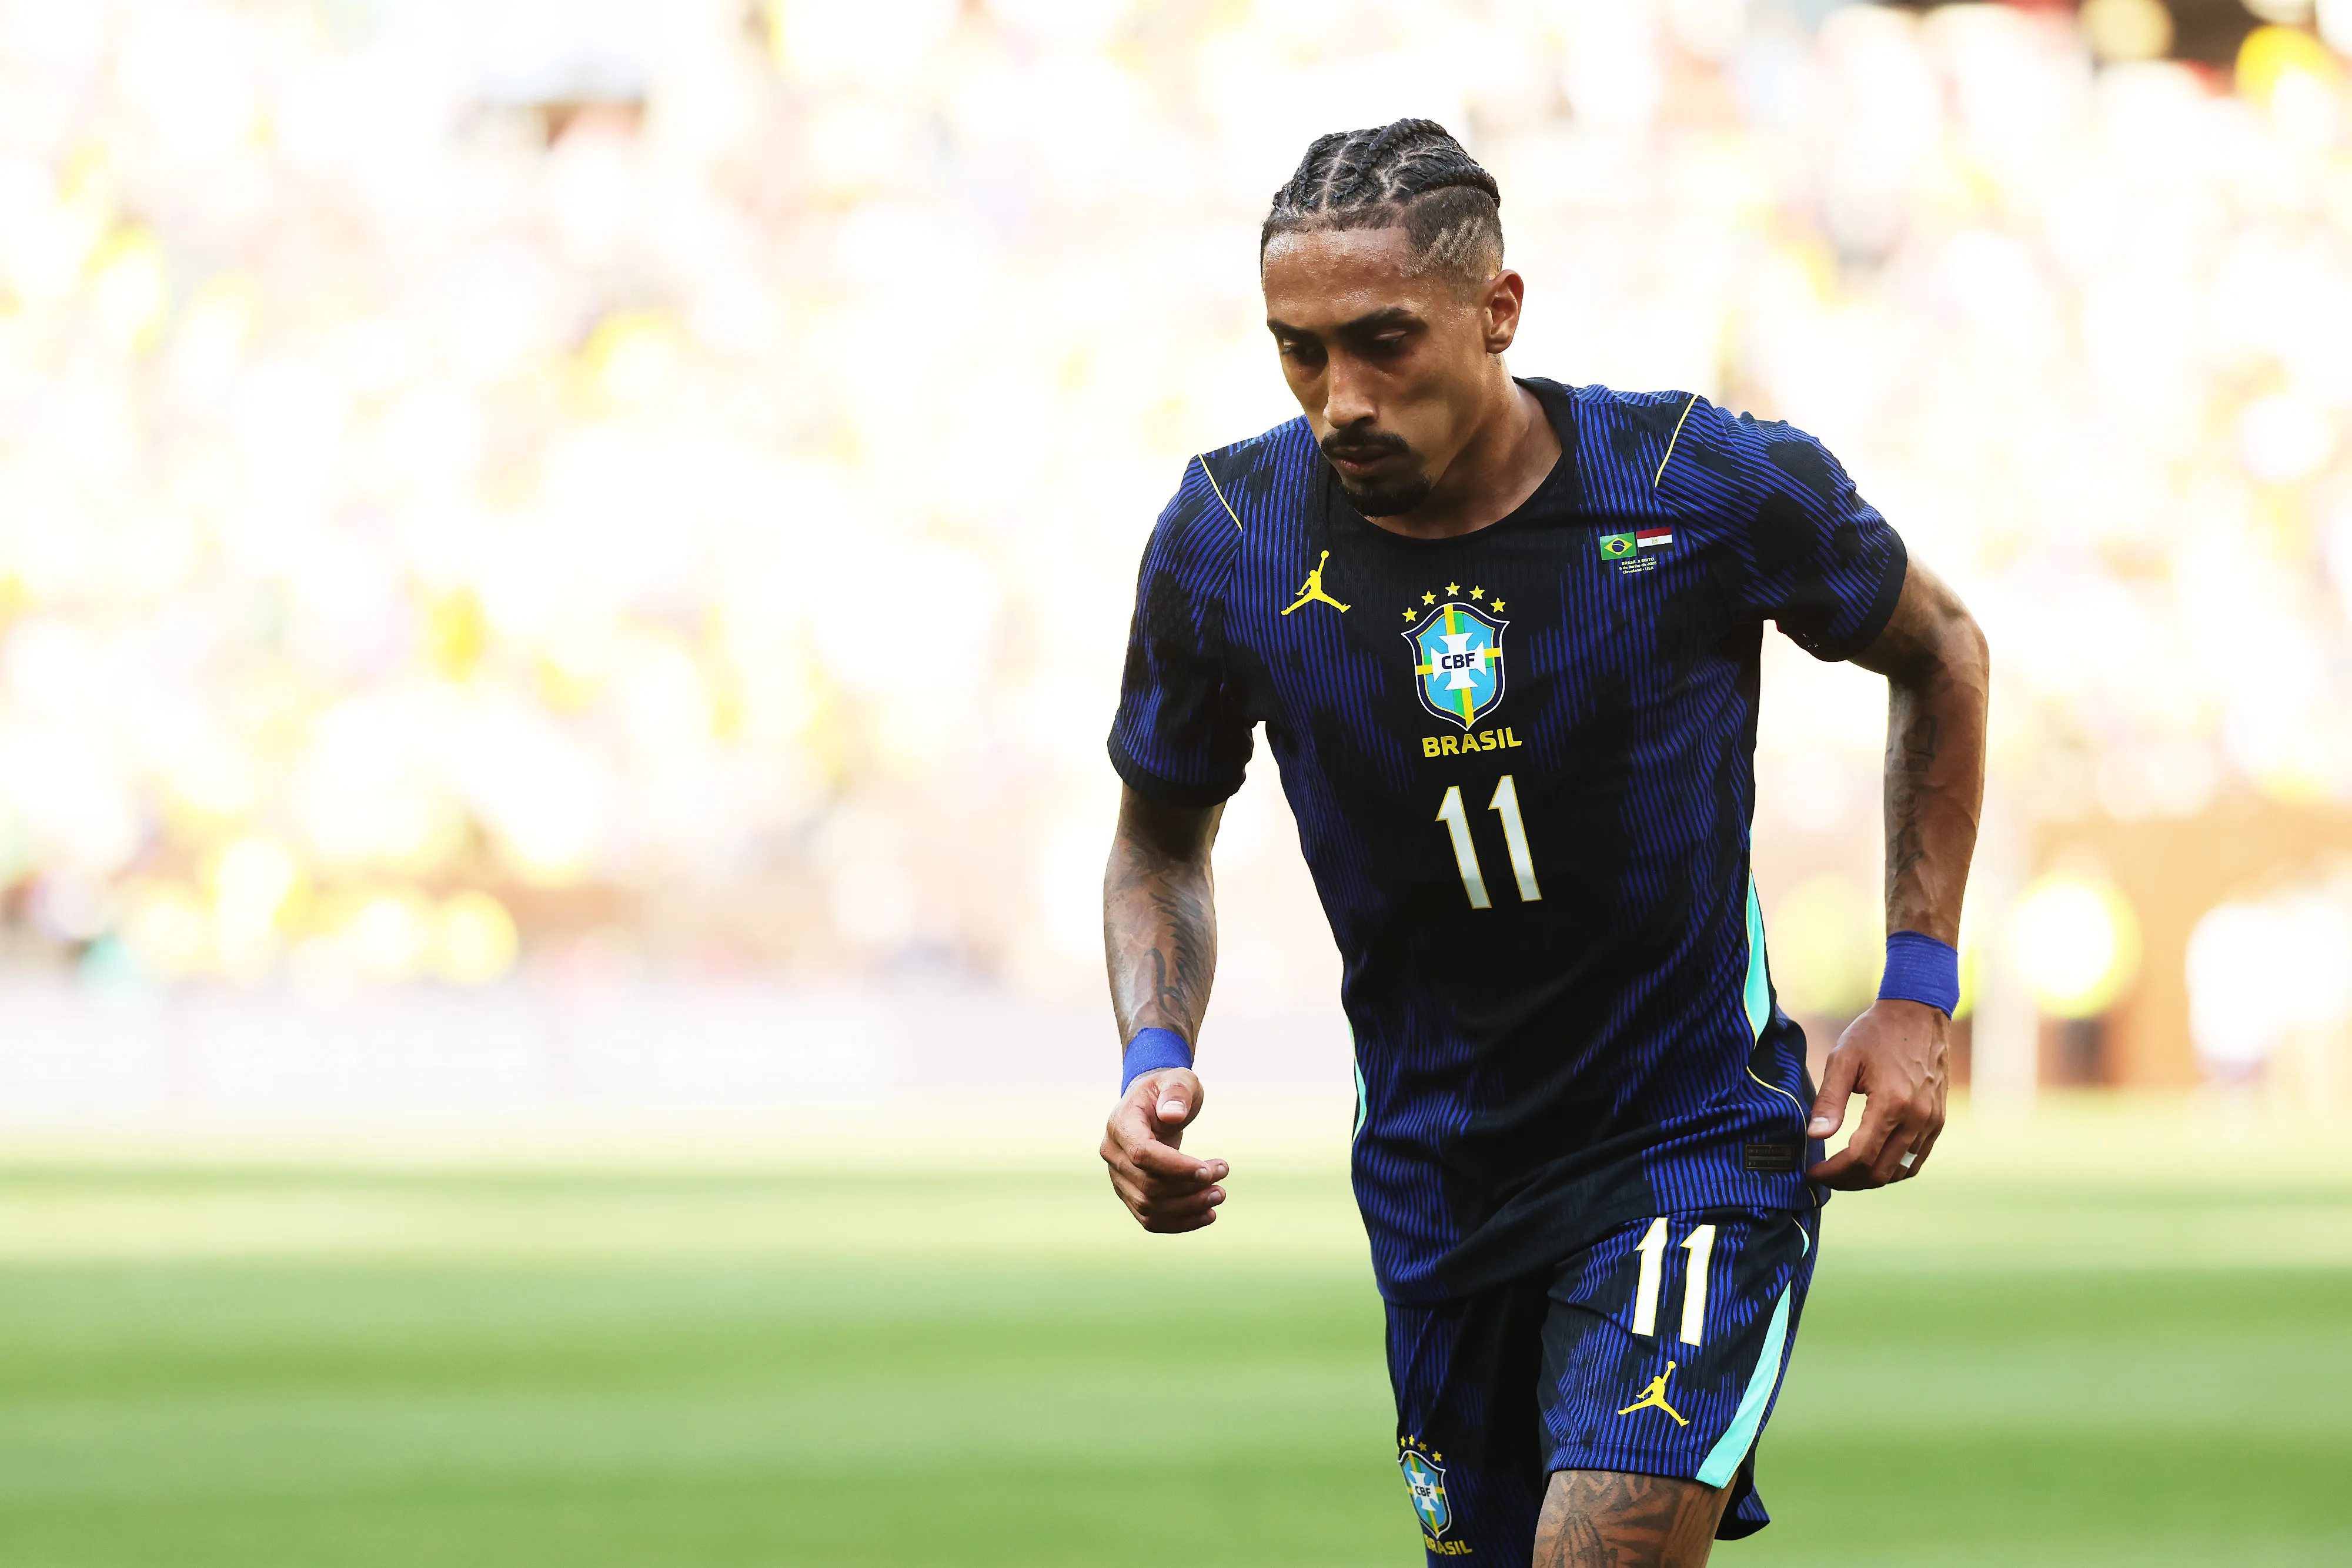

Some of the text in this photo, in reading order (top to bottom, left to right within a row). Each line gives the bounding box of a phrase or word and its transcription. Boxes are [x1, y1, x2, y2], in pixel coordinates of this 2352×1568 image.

[1441, 653, 1475, 669] CBF
[1422, 727, 1522, 757] BRASIL
[1435, 774, 1542, 908] 11
[1632, 1217, 1716, 1346] 11
[1415, 1486, 1431, 1497] CBF
